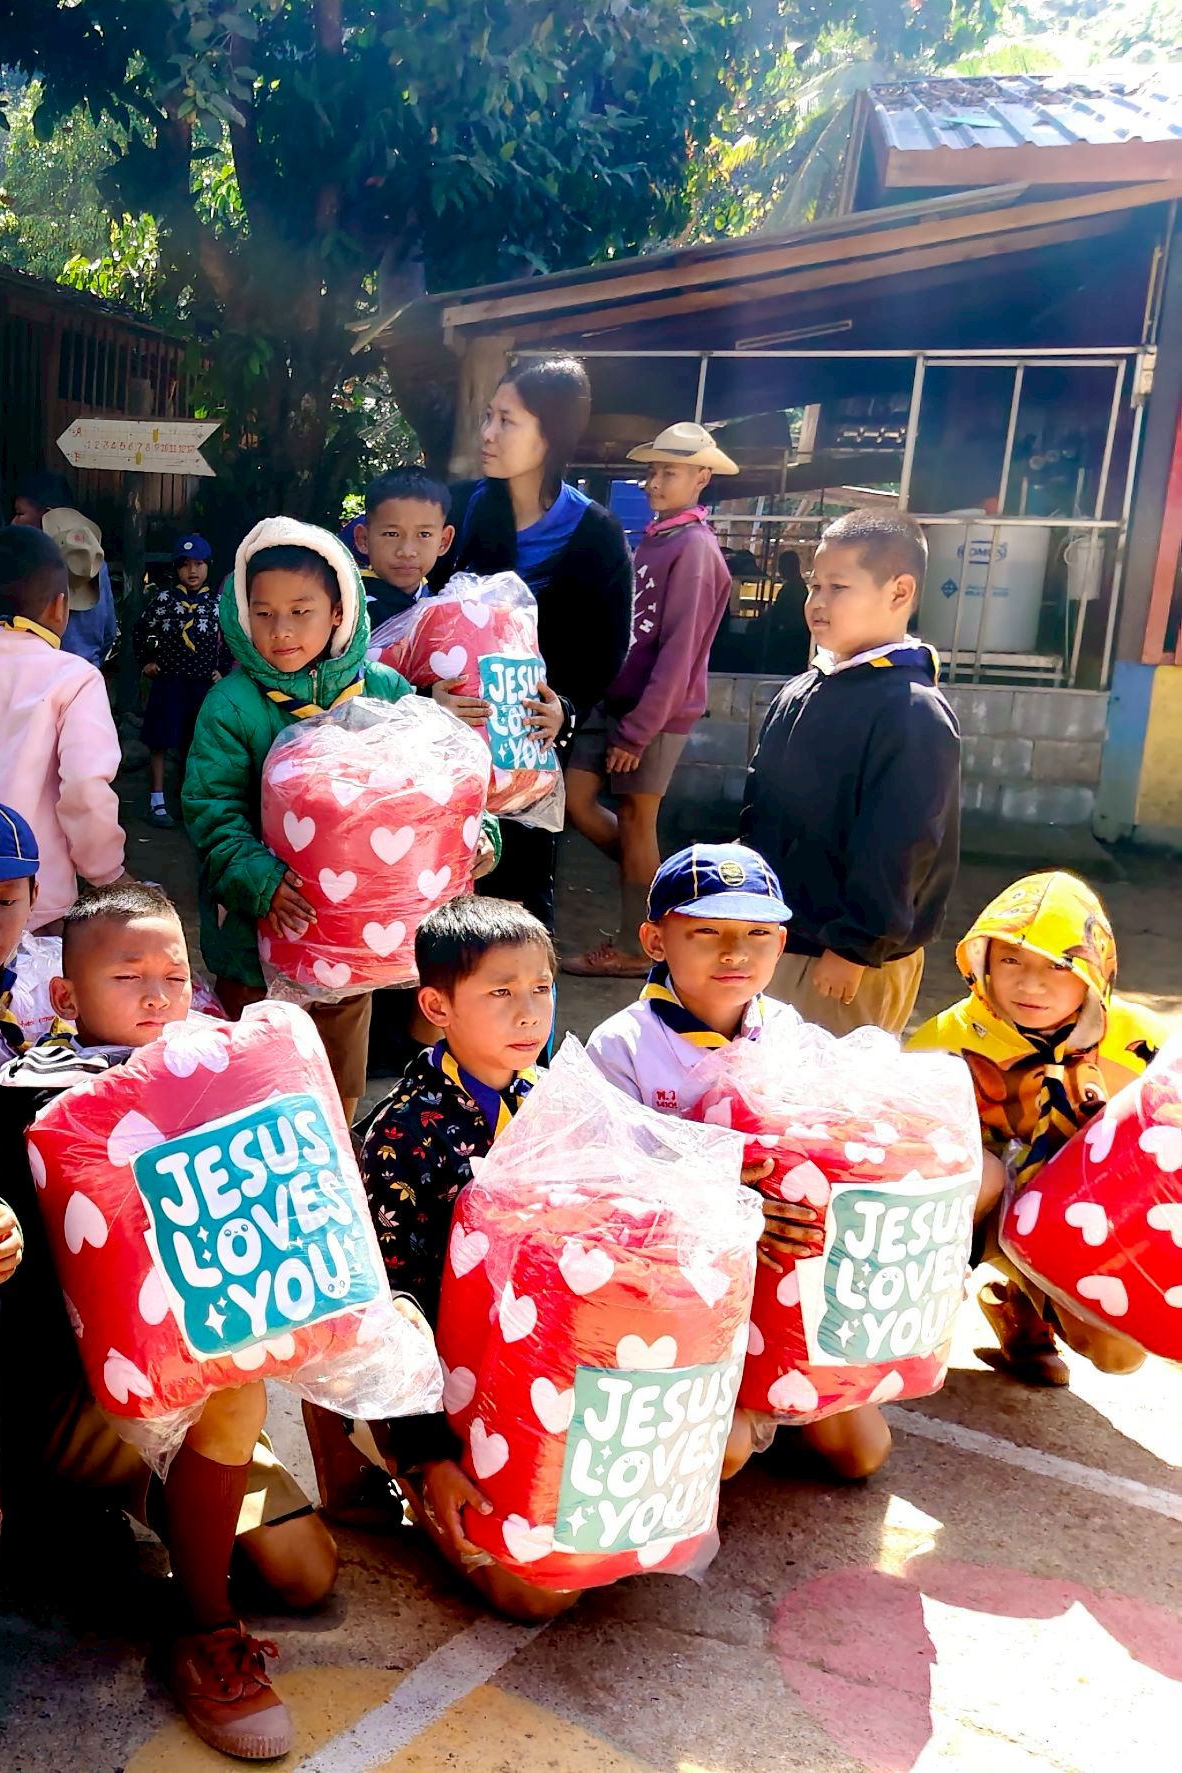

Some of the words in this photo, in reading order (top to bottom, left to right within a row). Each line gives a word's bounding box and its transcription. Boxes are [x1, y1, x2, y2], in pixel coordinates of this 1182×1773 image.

[155, 1110, 331, 1226] JESUS
[172, 1169, 353, 1288] LOVES
[844, 1194, 976, 1263] JESUS
[227, 1232, 351, 1338] YOU
[863, 1293, 951, 1359] YOU
[583, 1365, 739, 1447] JESUS
[570, 1419, 726, 1496] LOVES
[597, 1477, 700, 1548] YOU
